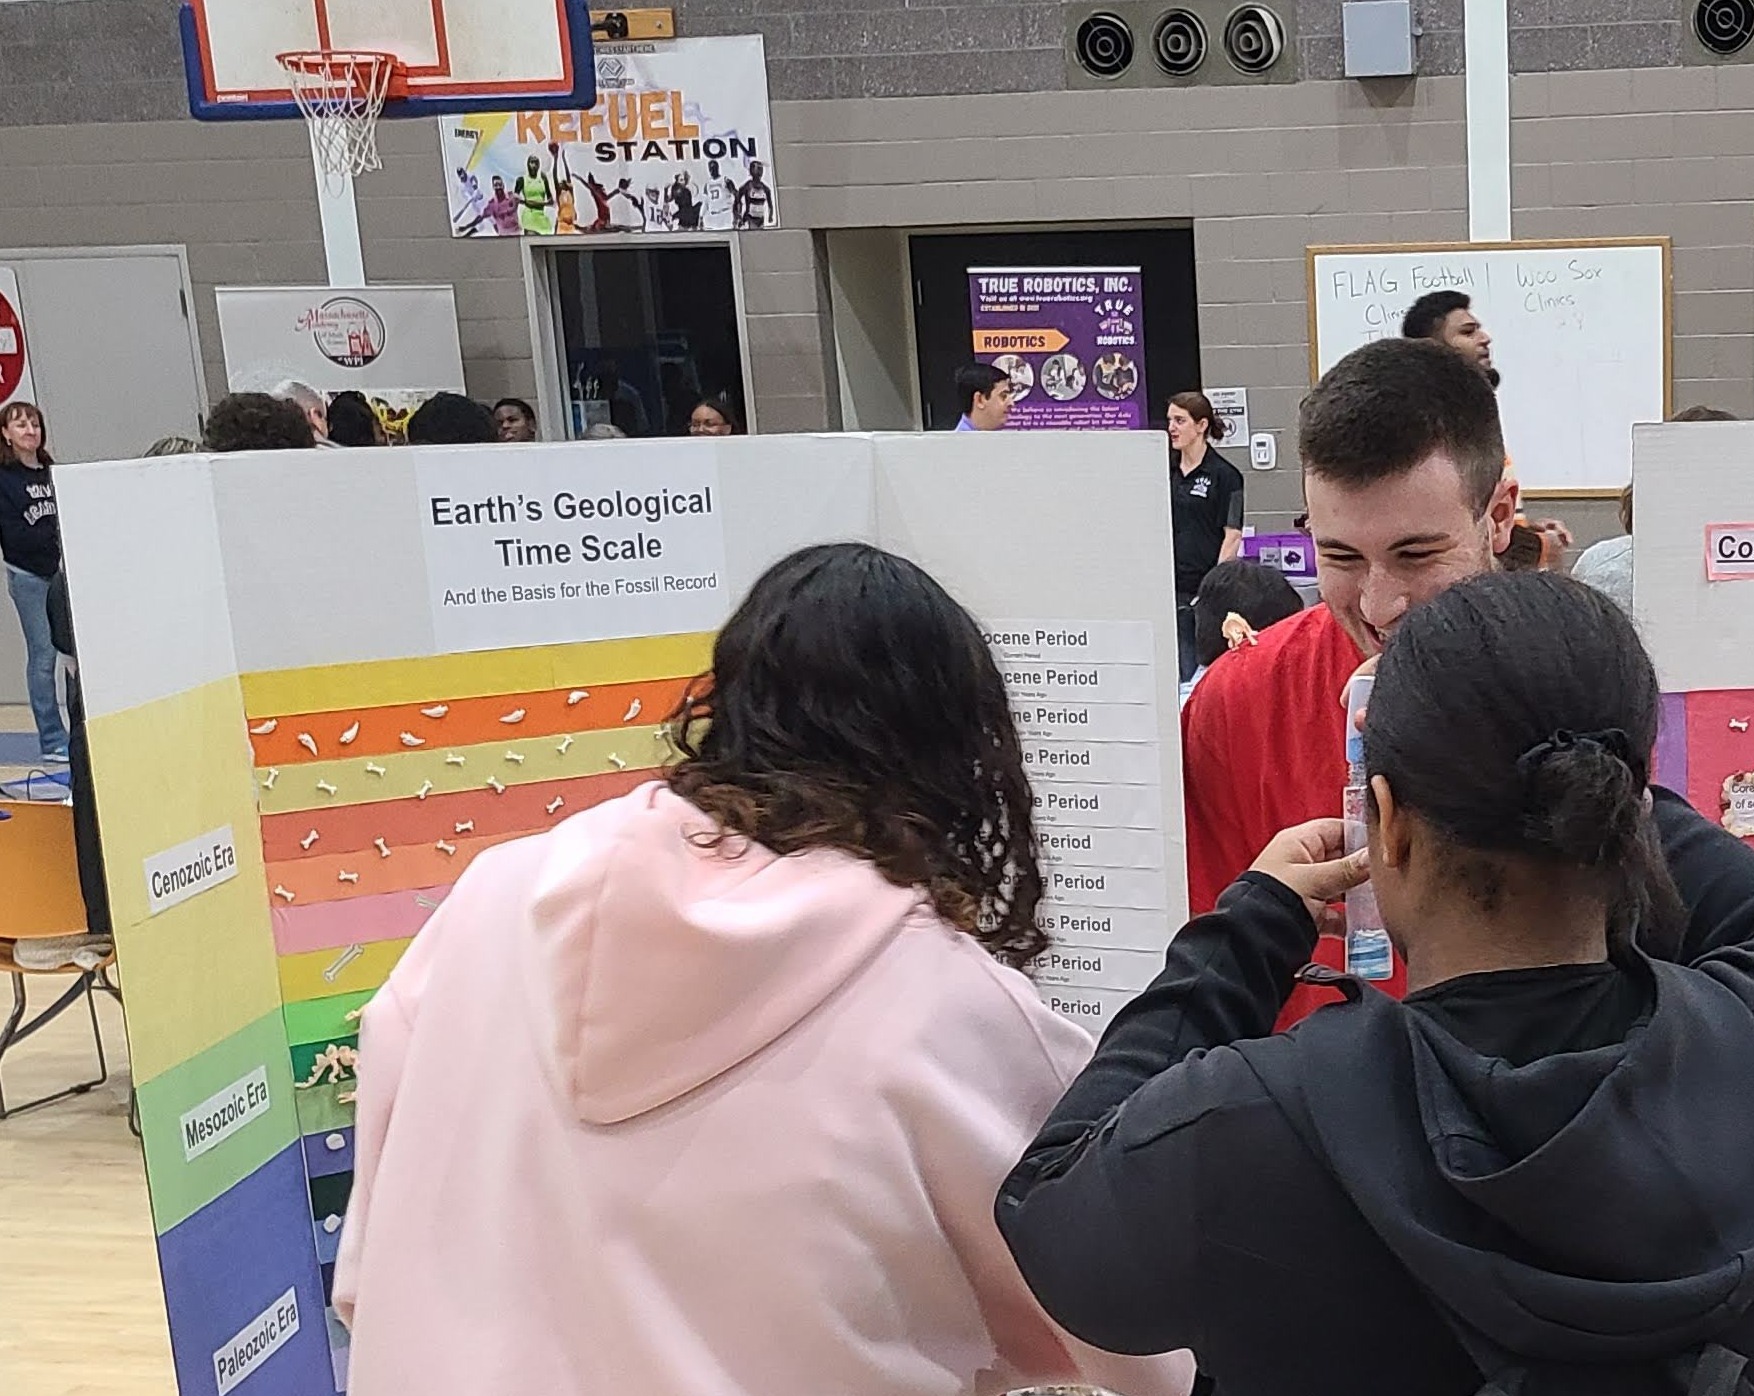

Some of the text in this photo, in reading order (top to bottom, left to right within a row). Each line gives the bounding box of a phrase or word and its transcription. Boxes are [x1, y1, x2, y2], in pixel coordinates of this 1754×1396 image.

[516, 91, 700, 144] REFUEL
[595, 138, 756, 163] STATION
[1333, 264, 1474, 299] FLAG Football
[1516, 259, 1604, 288] Woo Sox
[978, 277, 1132, 294] TRUE ROBOTICS, INC.
[1094, 299, 1134, 316] TRUE
[1524, 293, 1575, 313] Clinics
[984, 336, 1045, 348] ROBOTICS
[1097, 336, 1134, 345] ROBOTICS
[431, 487, 713, 526] Earth's Geological
[495, 533, 662, 567] Time Scale
[443, 573, 717, 606] And the Basis for the Fossil Record
[982, 630, 1087, 646] ocene Period
[1047, 670, 1098, 685] Period
[1037, 708, 1088, 723] Period
[1039, 749, 1090, 765] Period
[1731, 783, 1754, 794] Core
[1048, 793, 1099, 809] Period
[1735, 799, 1744, 809] of
[1040, 833, 1091, 849] Period
[152, 844, 234, 898] Cenozoic Era
[1054, 874, 1105, 890] Period
[1060, 915, 1111, 932] Period
[1051, 954, 1101, 971] Period
[1051, 998, 1101, 1015] Period
[186, 1082, 267, 1149] Mesozoic Era
[218, 1304, 296, 1384] Paleozoic Era
